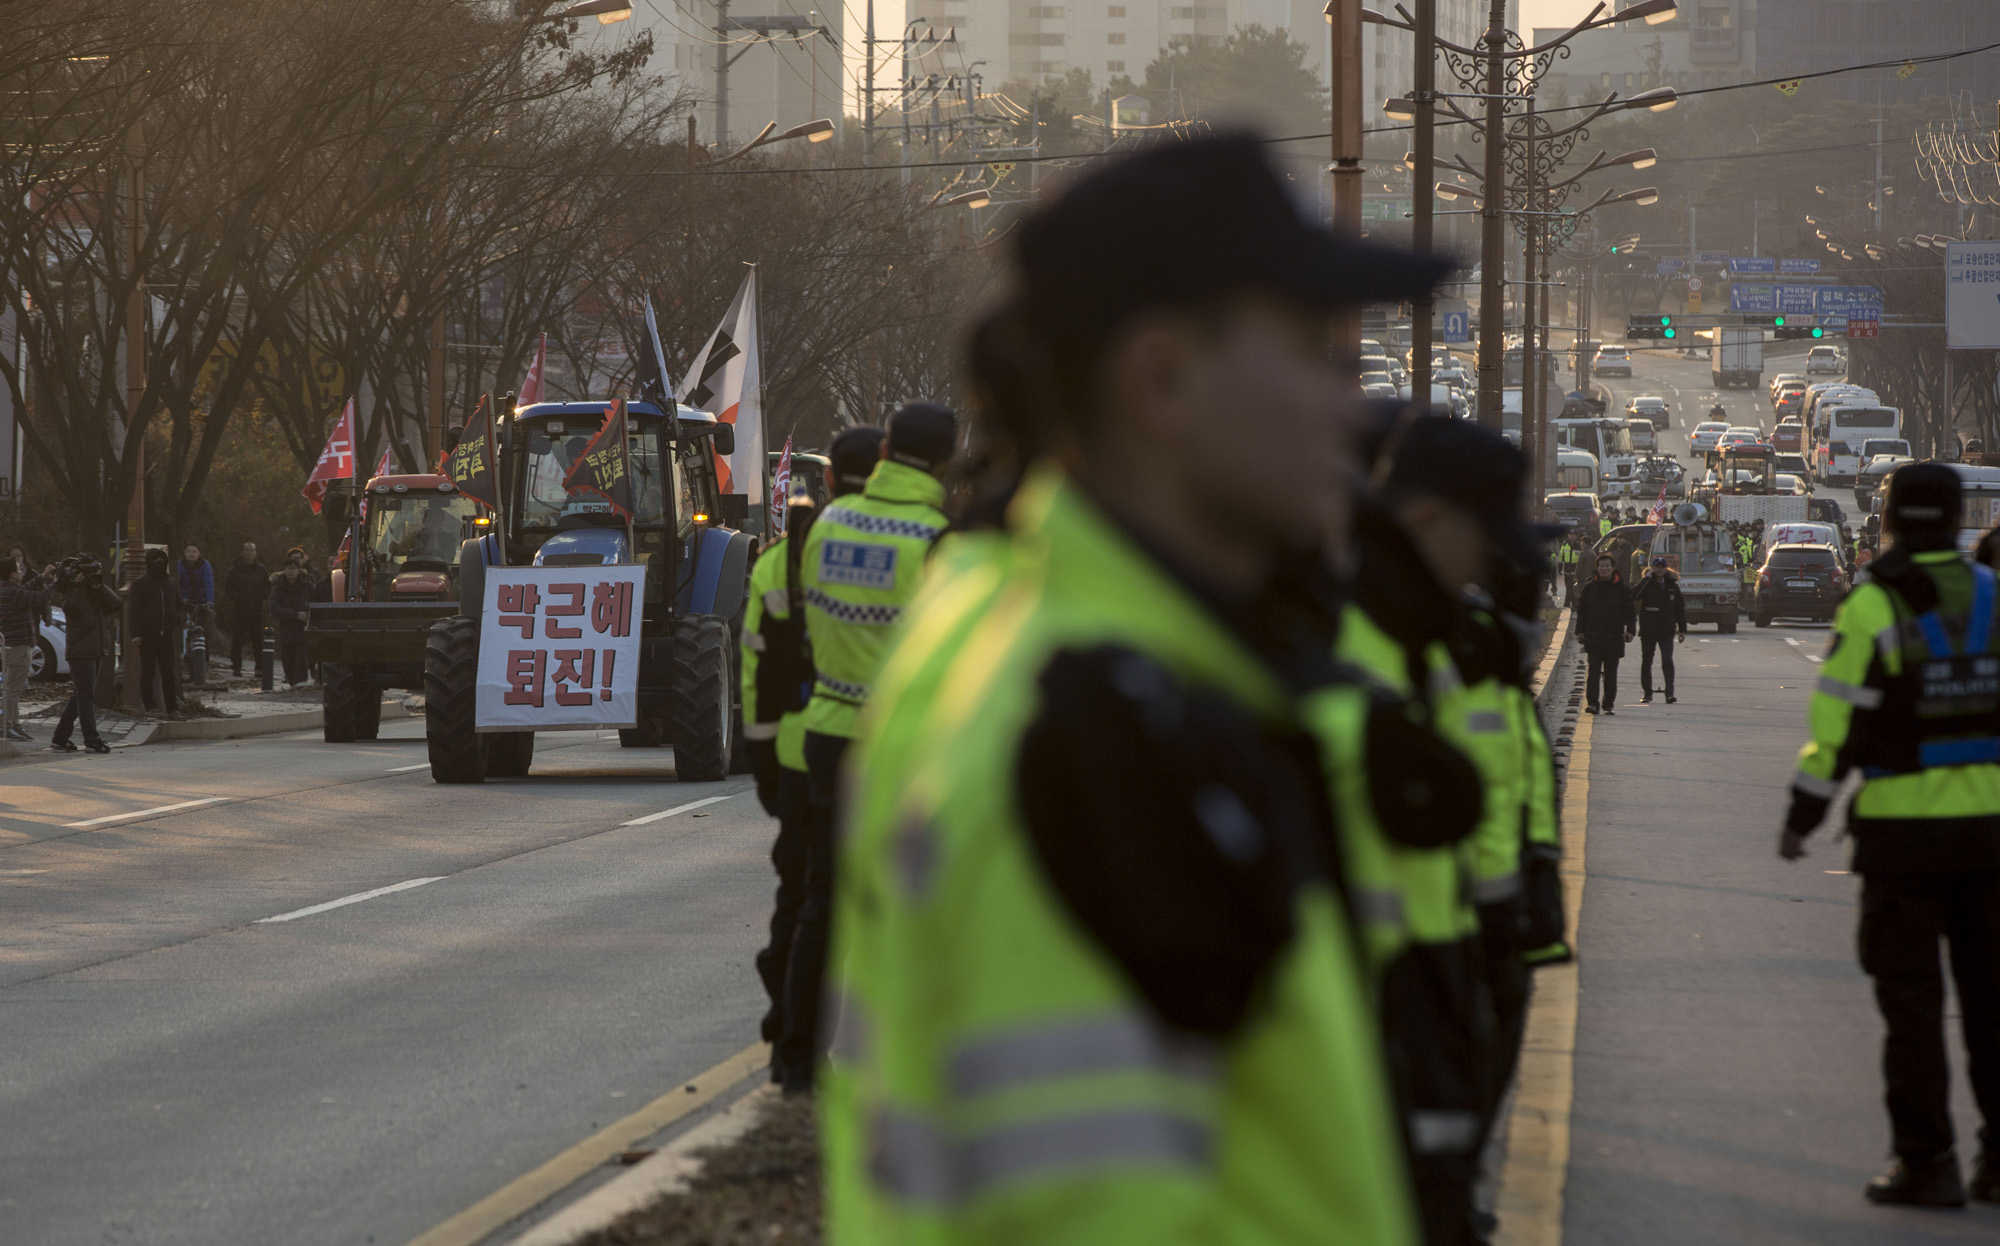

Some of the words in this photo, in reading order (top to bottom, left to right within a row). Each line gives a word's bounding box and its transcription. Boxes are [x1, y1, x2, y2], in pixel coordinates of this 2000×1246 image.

[1850, 309, 1877, 319] 신호준수
[825, 568, 885, 583] POLICE
[497, 581, 634, 639] 박근혜
[504, 648, 616, 707] 퇴진!
